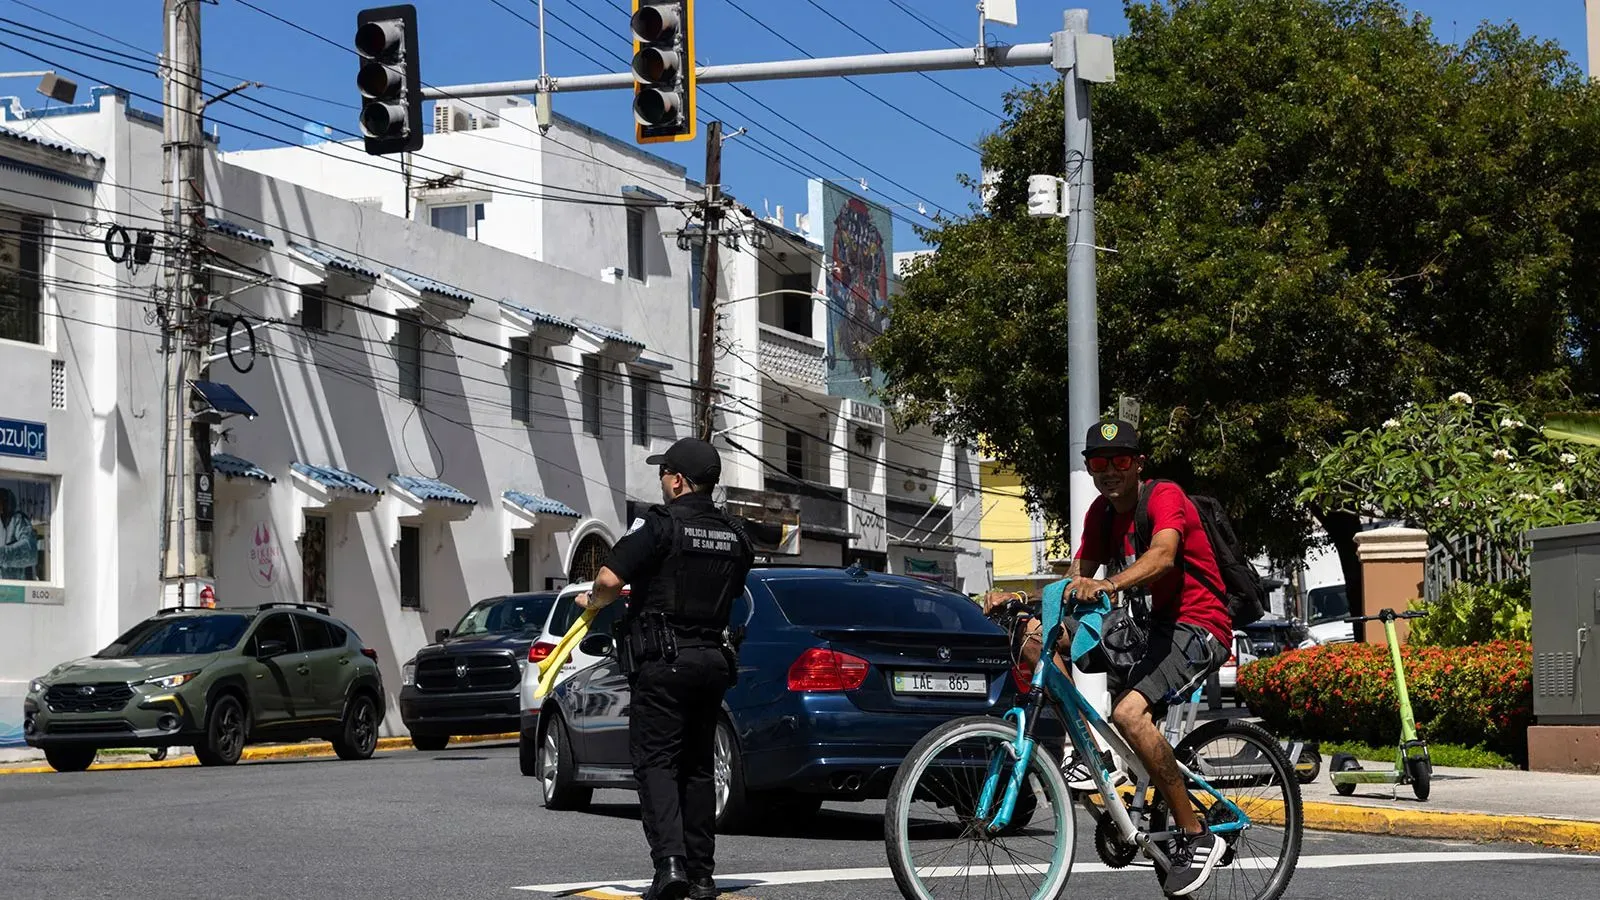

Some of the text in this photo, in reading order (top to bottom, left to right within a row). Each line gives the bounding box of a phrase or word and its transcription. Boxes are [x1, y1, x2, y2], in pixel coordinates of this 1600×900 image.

[684, 527, 738, 542] POLICIA MUNICIPAL
[692, 538, 731, 551] DE SAN JUAN
[912, 674, 970, 691] IAE 865
